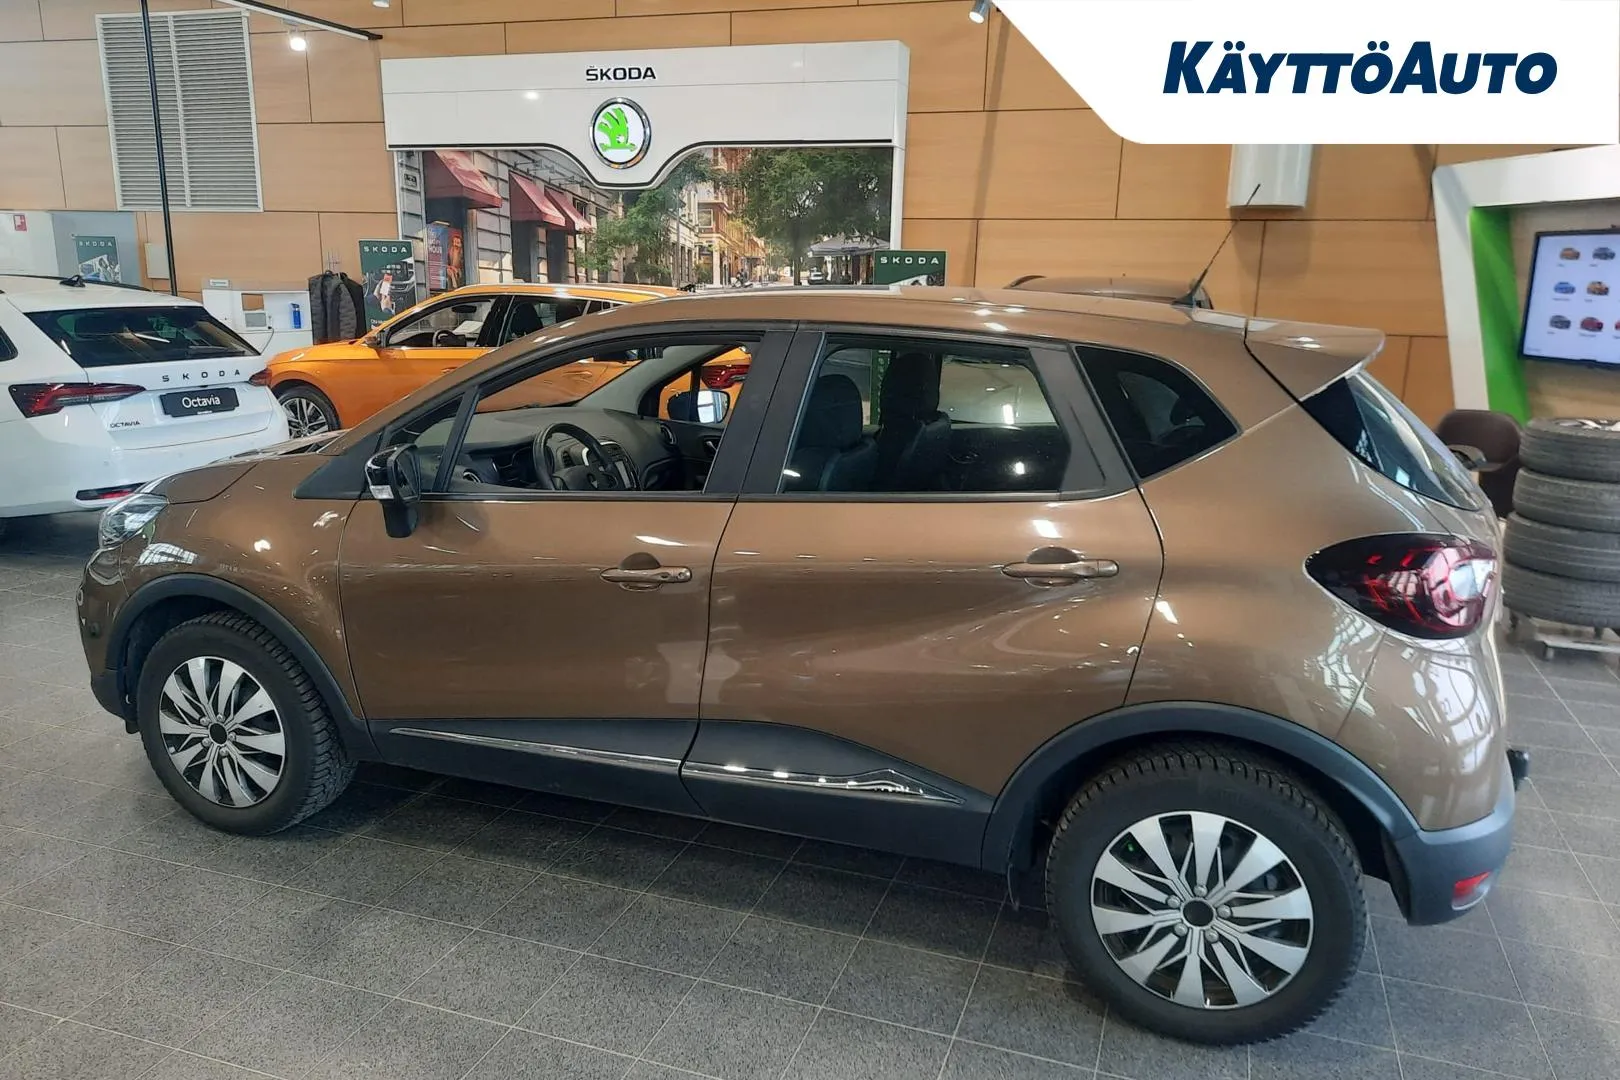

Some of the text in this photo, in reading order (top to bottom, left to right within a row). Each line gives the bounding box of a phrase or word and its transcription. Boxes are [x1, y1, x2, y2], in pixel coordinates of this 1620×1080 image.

[586, 65, 656, 81] ŠKODA
[880, 256, 939, 265] SKODA
[162, 369, 241, 383] SKODA
[181, 394, 221, 409] Octavia
[109, 420, 141, 429] OCTAVIA
